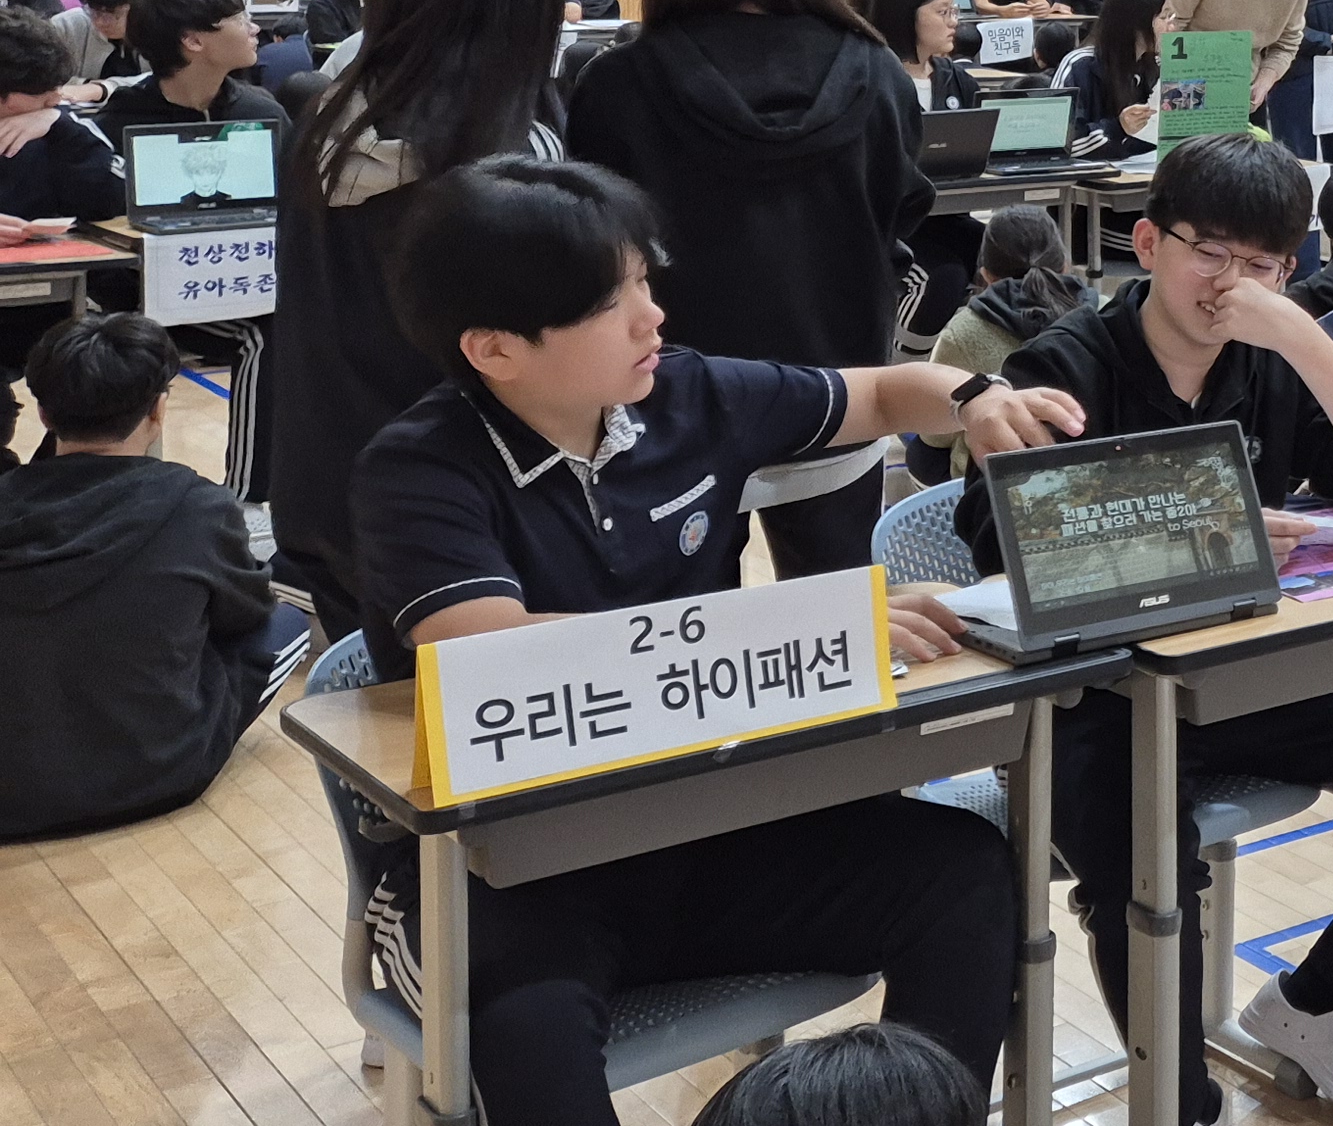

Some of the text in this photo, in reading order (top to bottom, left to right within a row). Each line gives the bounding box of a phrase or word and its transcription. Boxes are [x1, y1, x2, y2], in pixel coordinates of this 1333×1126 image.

[993, 39, 1021, 56] 친구들
[1171, 36, 1188, 60] 1
[178, 239, 275, 267] 천상천하
[178, 273, 276, 301] 유아독존
[1061, 491, 1187, 523] 전통과 현대가 만나는
[1100, 512, 1138, 530] 찾으러
[1139, 509, 1164, 524] 가는
[1167, 522, 1181, 532] to
[1138, 593, 1171, 609] ASUS
[628, 605, 707, 656] 2-6
[469, 629, 853, 763] 우리는 하이패션
